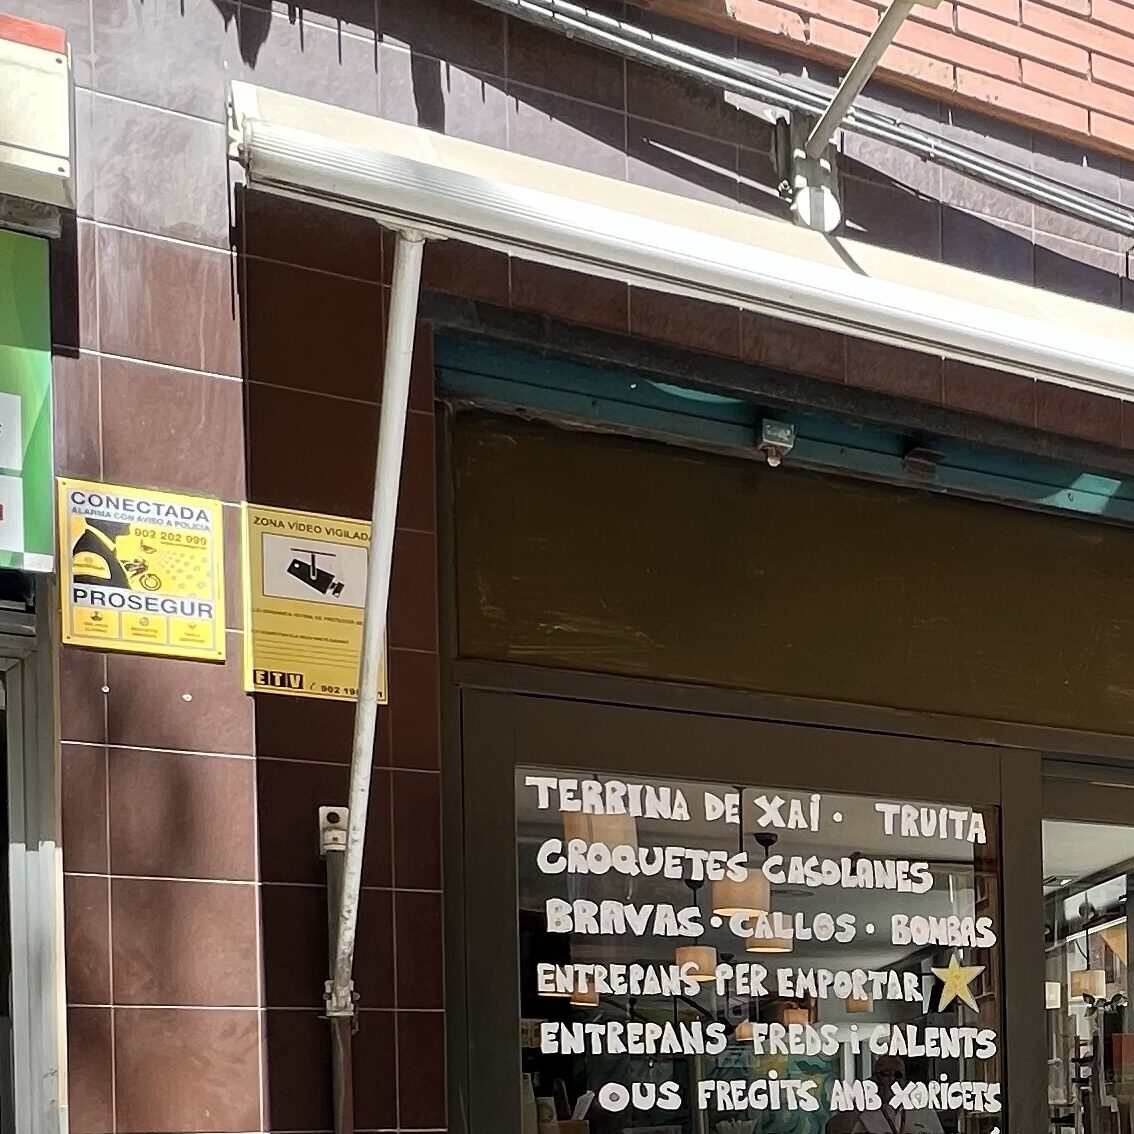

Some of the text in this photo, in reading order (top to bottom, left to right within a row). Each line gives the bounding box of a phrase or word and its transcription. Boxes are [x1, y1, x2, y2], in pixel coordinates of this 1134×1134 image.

[70, 491, 210, 523] CONECTADA
[71, 506, 112, 518] ALARMA
[113, 509, 135, 522] CON
[136, 512, 164, 526] AVISO
[134, 528, 157, 539] 902
[160, 531, 182, 542] 202
[186, 534, 207, 546] 999
[253, 516, 285, 529] ZONA
[288, 520, 322, 534] VÍDEO
[73, 588, 213, 619] PROSEGUR
[254, 670, 303, 690] ETV
[525, 776, 690, 821] TERRINA
[704, 792, 740, 825] DE
[536, 838, 935, 894] CROQUETES CASOLANES
[545, 897, 997, 949] BRAVAS CALLOS BOMBAS
[536, 961, 924, 1002] ENTREPANS PER EMPORTAR
[540, 1021, 727, 1056] ENTREPANS
[752, 1022, 839, 1056] FREDS
[868, 1024, 998, 1059] CALENTS
[599, 1081, 682, 1112] OUS
[829, 1078, 881, 1112] AMB
